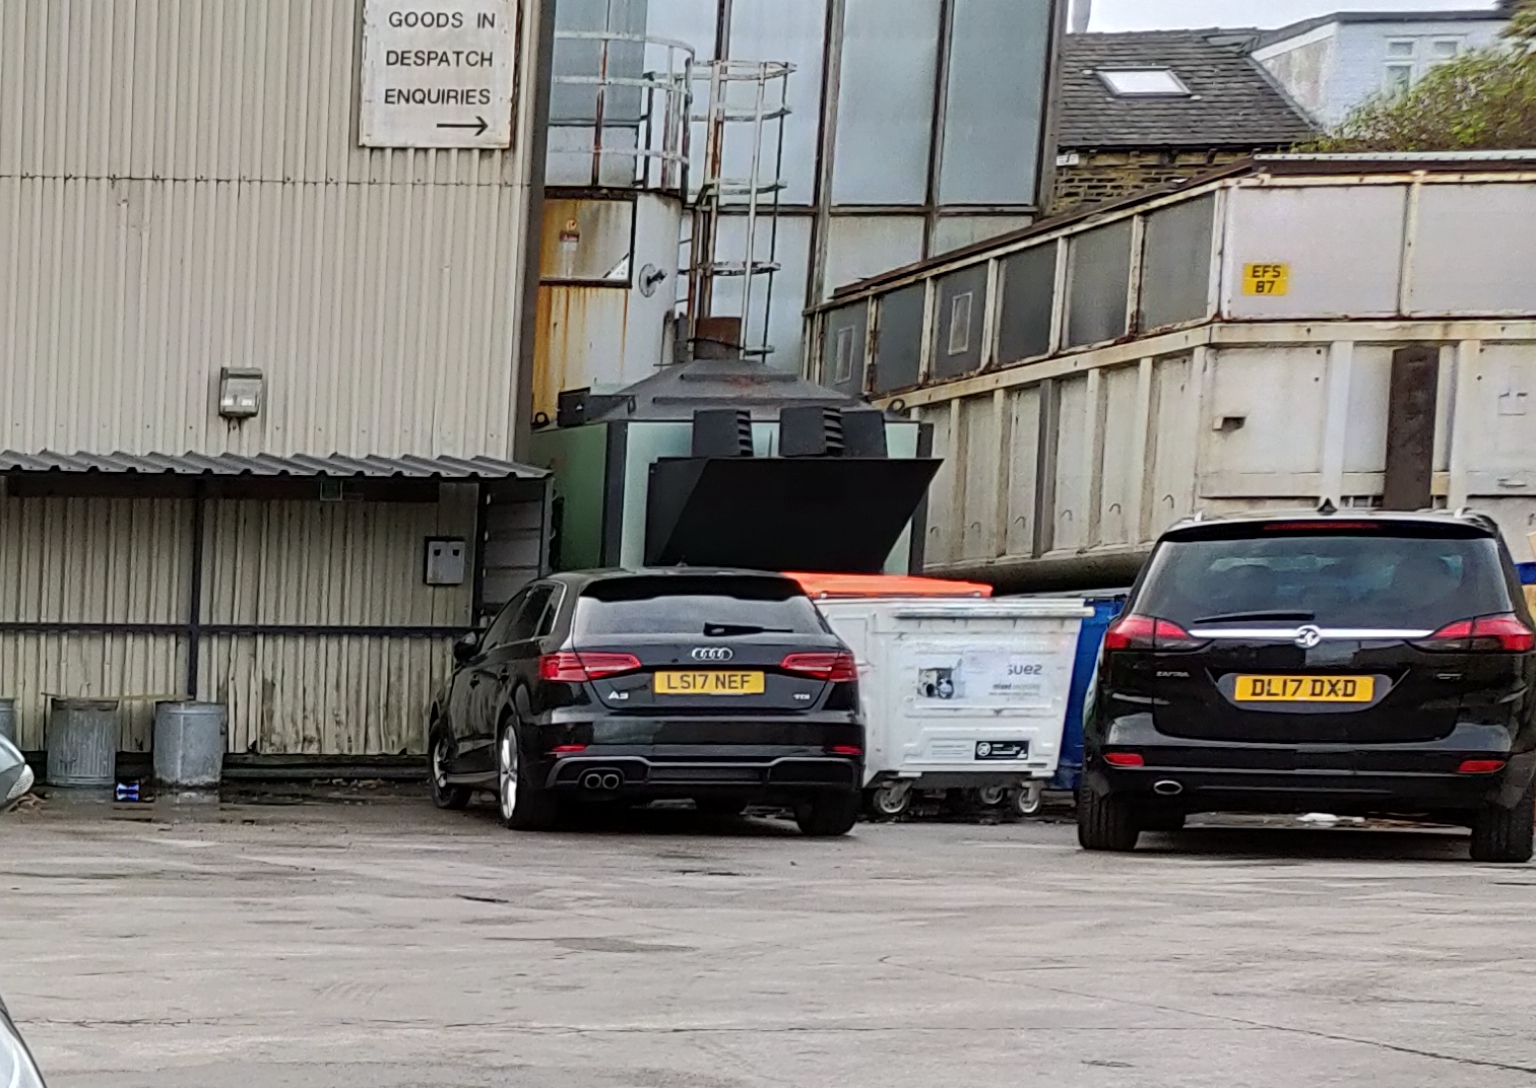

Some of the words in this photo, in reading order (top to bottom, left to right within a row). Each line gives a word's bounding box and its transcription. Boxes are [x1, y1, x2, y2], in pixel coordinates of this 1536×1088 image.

[388, 11, 464, 28] GOODS
[477, 12, 496, 29] IN
[386, 50, 494, 67] DESPATCH
[384, 88, 491, 105] ENQUIRIES
[1251, 264, 1282, 279] EFS
[667, 674, 710, 690] LS17
[714, 674, 751, 690] NEF
[1250, 678, 1303, 698] DL17
[1309, 678, 1358, 698] DXD
